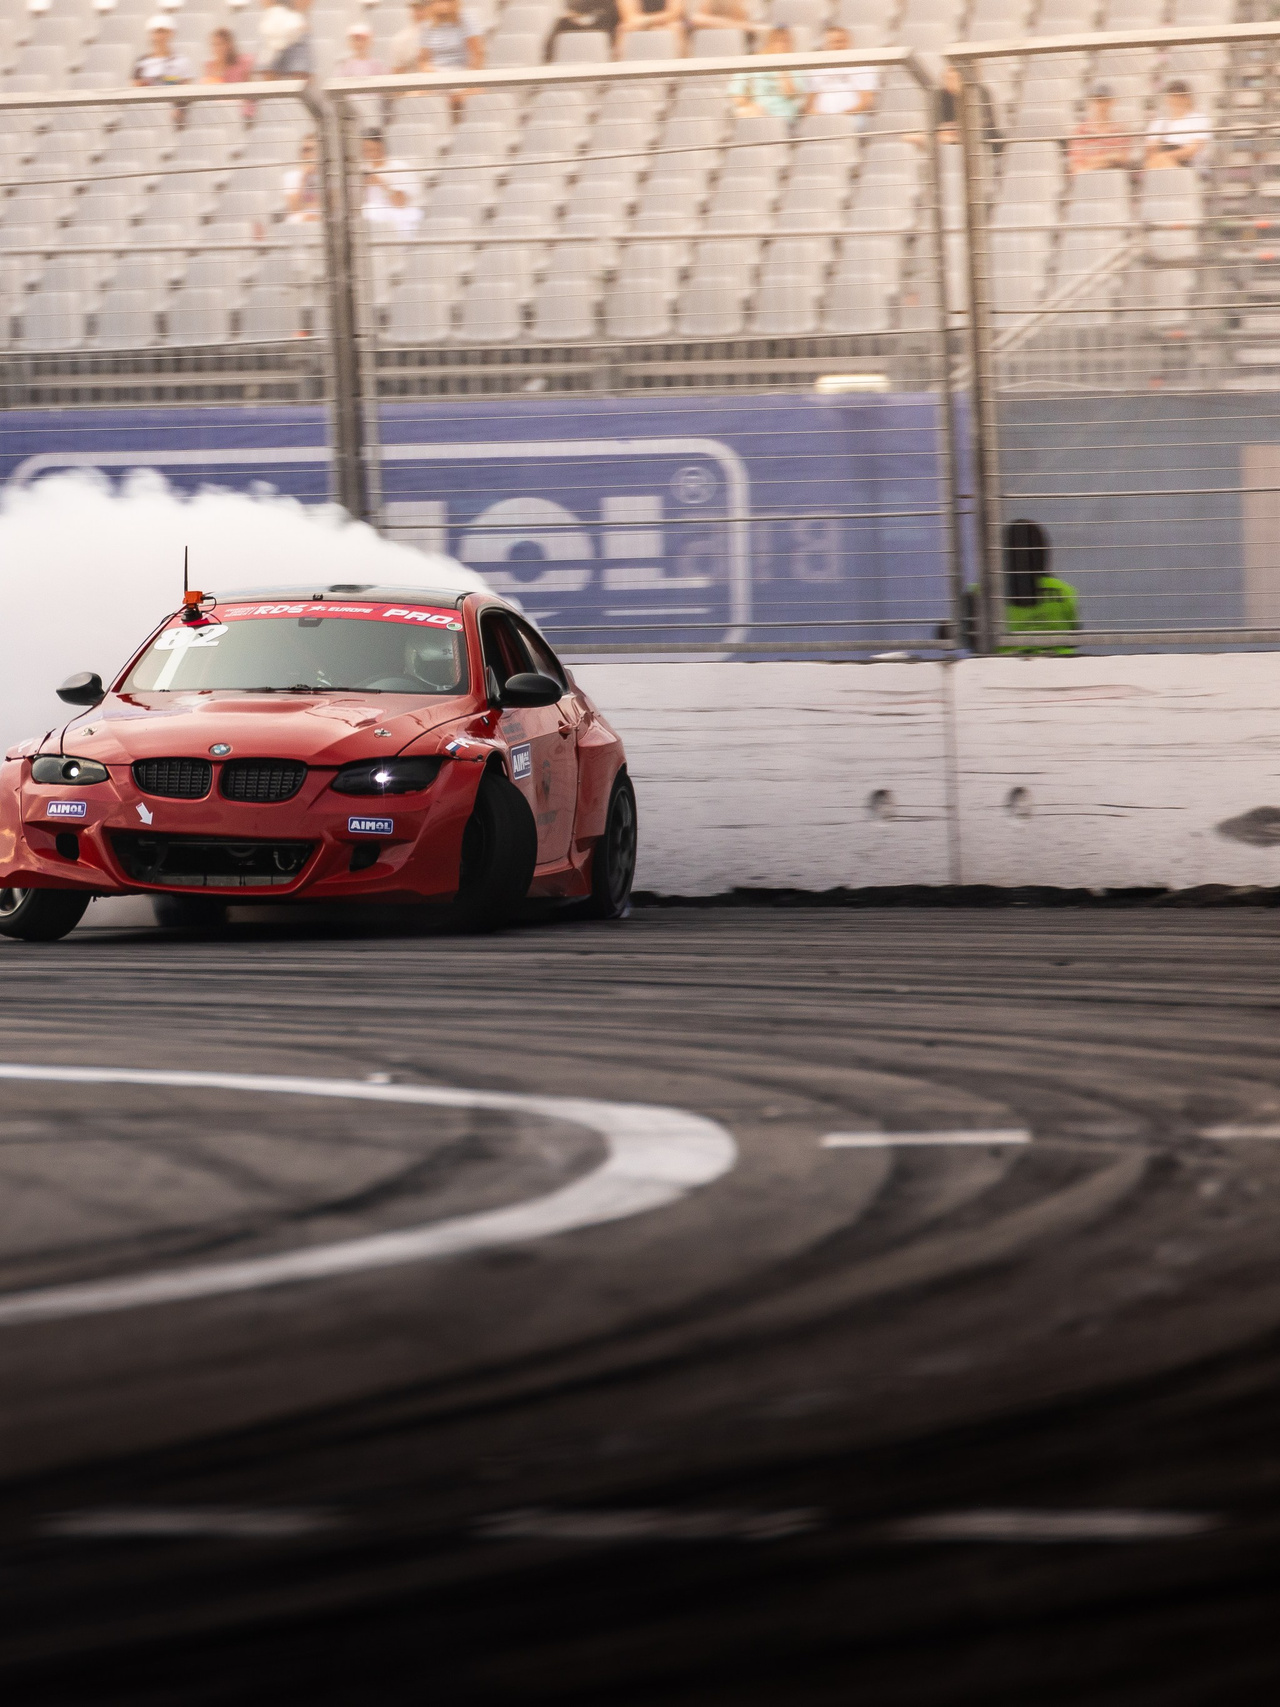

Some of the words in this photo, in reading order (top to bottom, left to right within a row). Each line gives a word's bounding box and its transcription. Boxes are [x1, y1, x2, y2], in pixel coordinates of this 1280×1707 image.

[253, 604, 310, 615] RDS
[327, 606, 374, 614] EUROPE
[382, 608, 454, 624] PRO
[153, 624, 229, 650] 82
[48, 804, 84, 814] AIMOL
[350, 820, 391, 831] AIMOL
